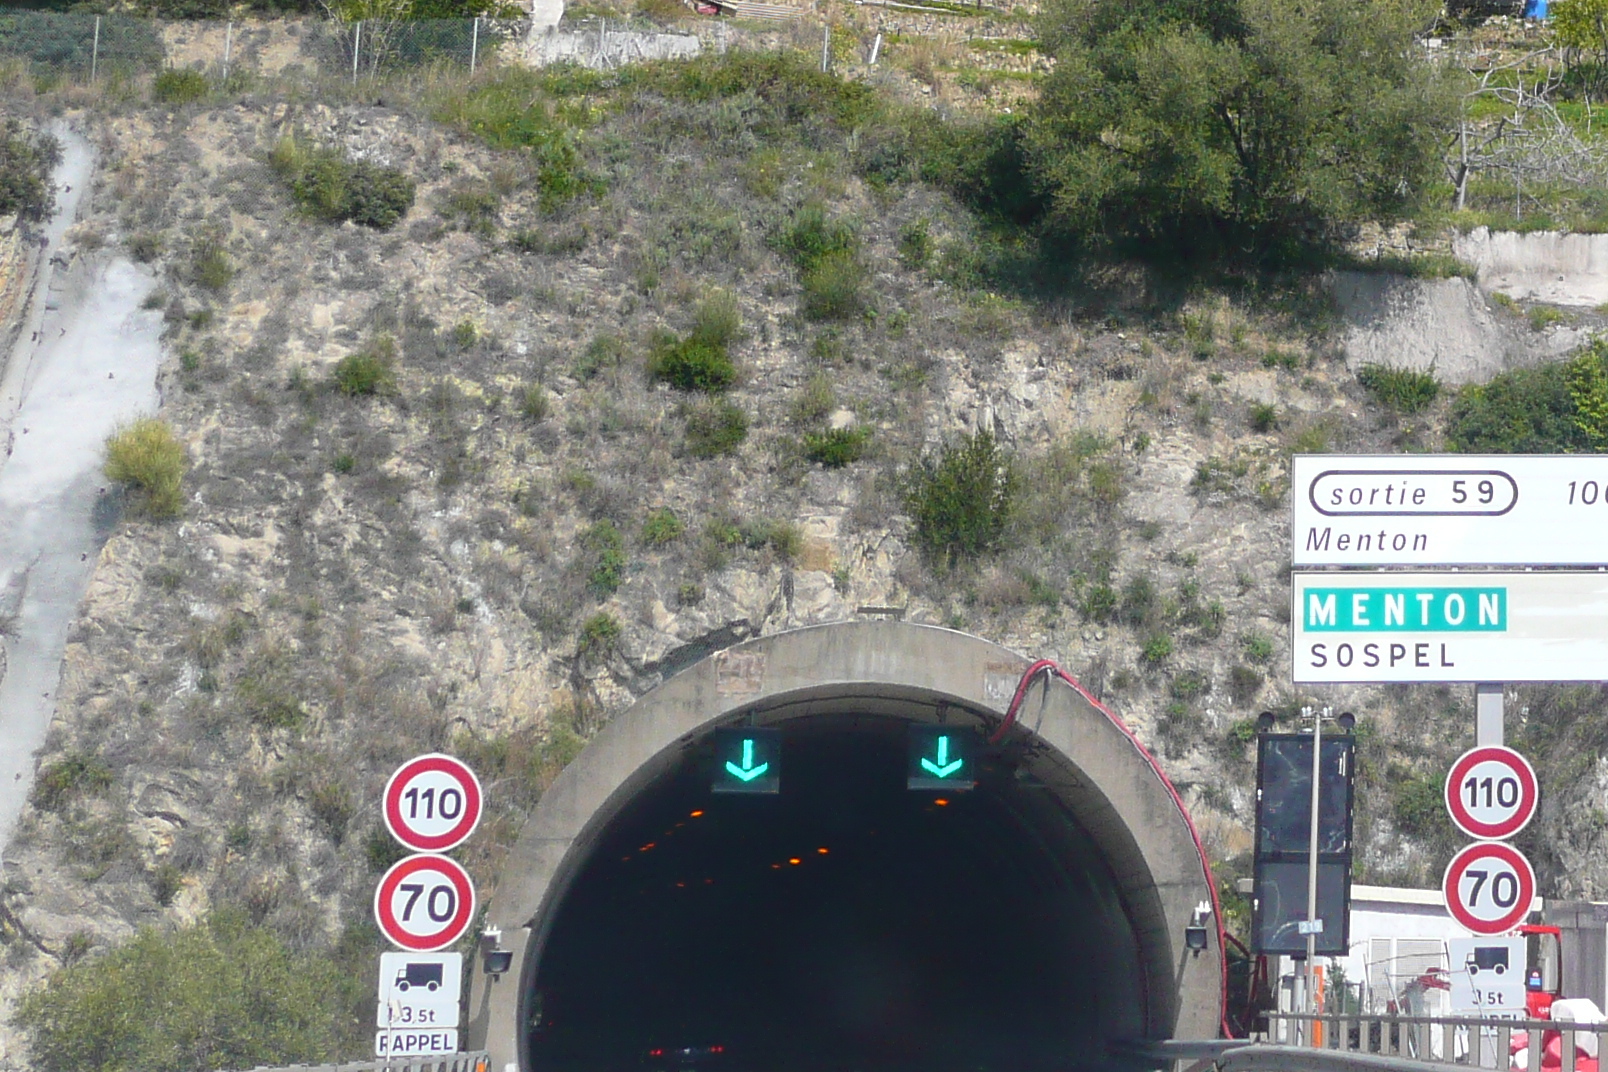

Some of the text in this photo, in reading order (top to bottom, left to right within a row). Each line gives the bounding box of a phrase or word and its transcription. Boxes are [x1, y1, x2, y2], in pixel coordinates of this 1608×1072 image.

[1330, 480, 1495, 505] sortie 59
[1306, 527, 1428, 551] Menton
[1309, 593, 1500, 627] MENTON
[1311, 643, 1455, 668] SOSPEL
[404, 787, 462, 820] 110
[1465, 776, 1519, 808] 110
[400, 884, 456, 923] 70
[1465, 870, 1518, 908] 70
